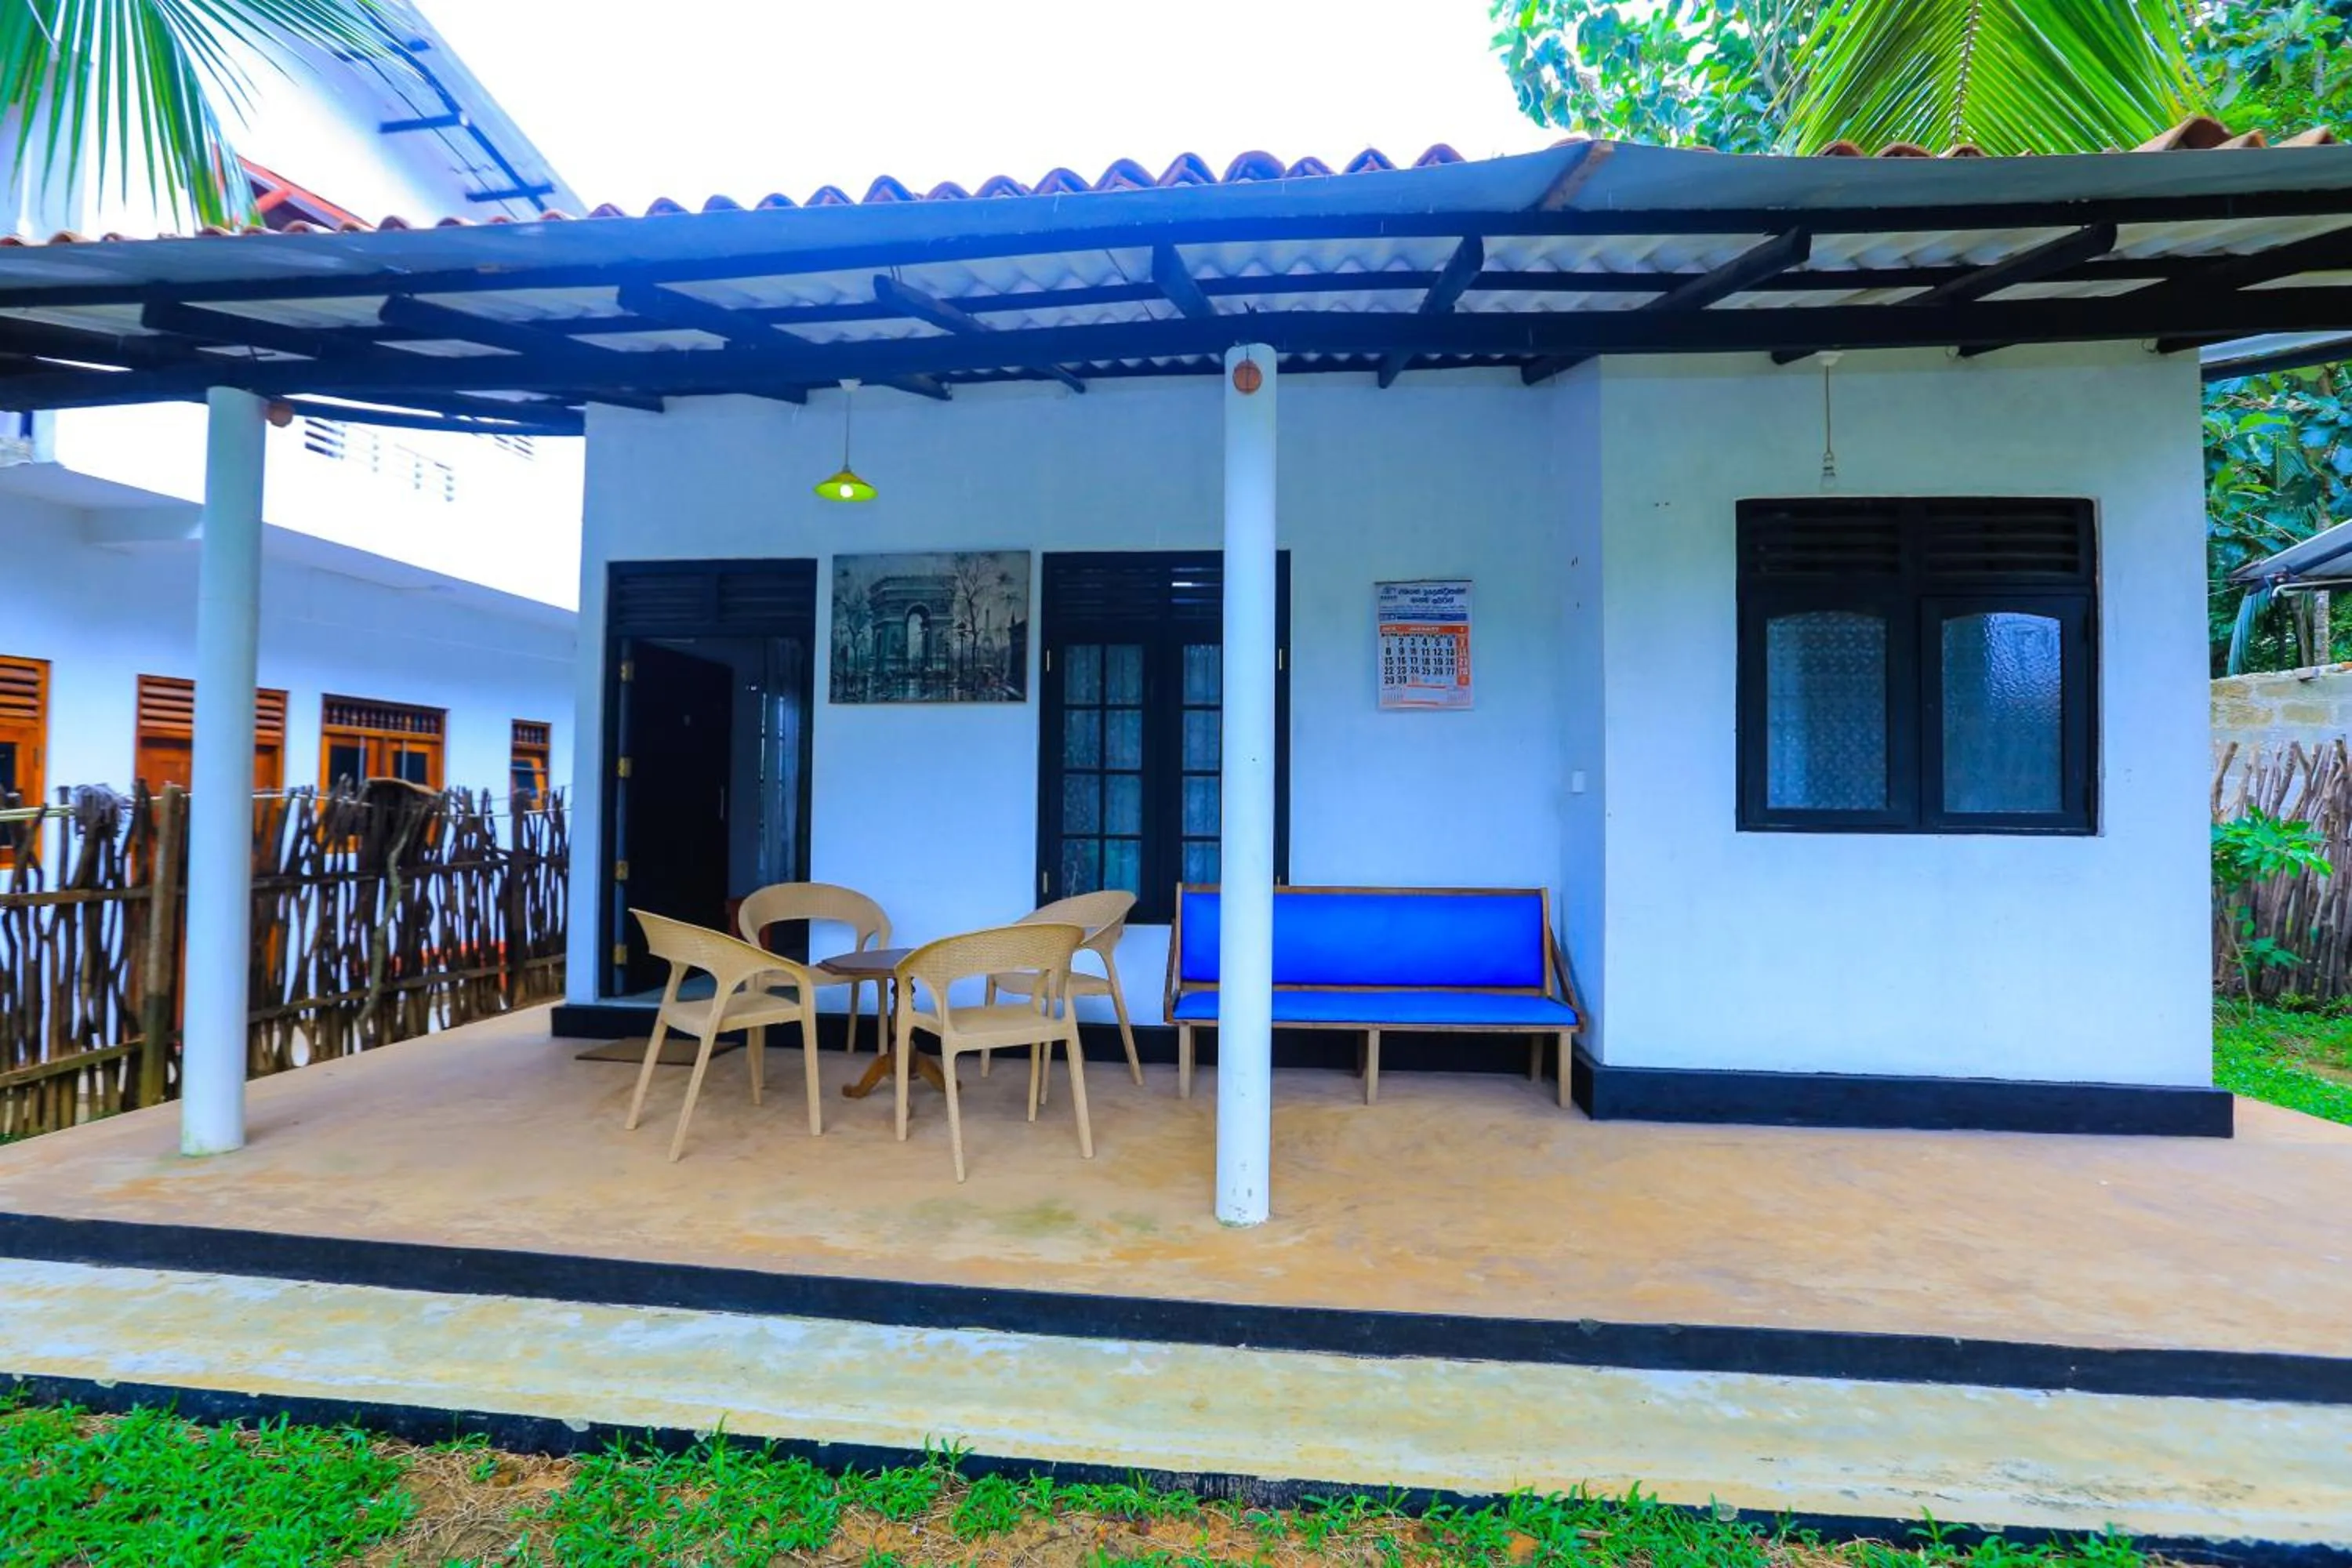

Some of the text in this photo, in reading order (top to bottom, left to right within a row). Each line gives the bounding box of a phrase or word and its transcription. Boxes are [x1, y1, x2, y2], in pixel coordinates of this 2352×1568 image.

[1385, 666, 1393, 675] 22
[1397, 666, 1406, 675] 23
[1410, 666, 1419, 675] 24
[1422, 666, 1430, 675] 25
